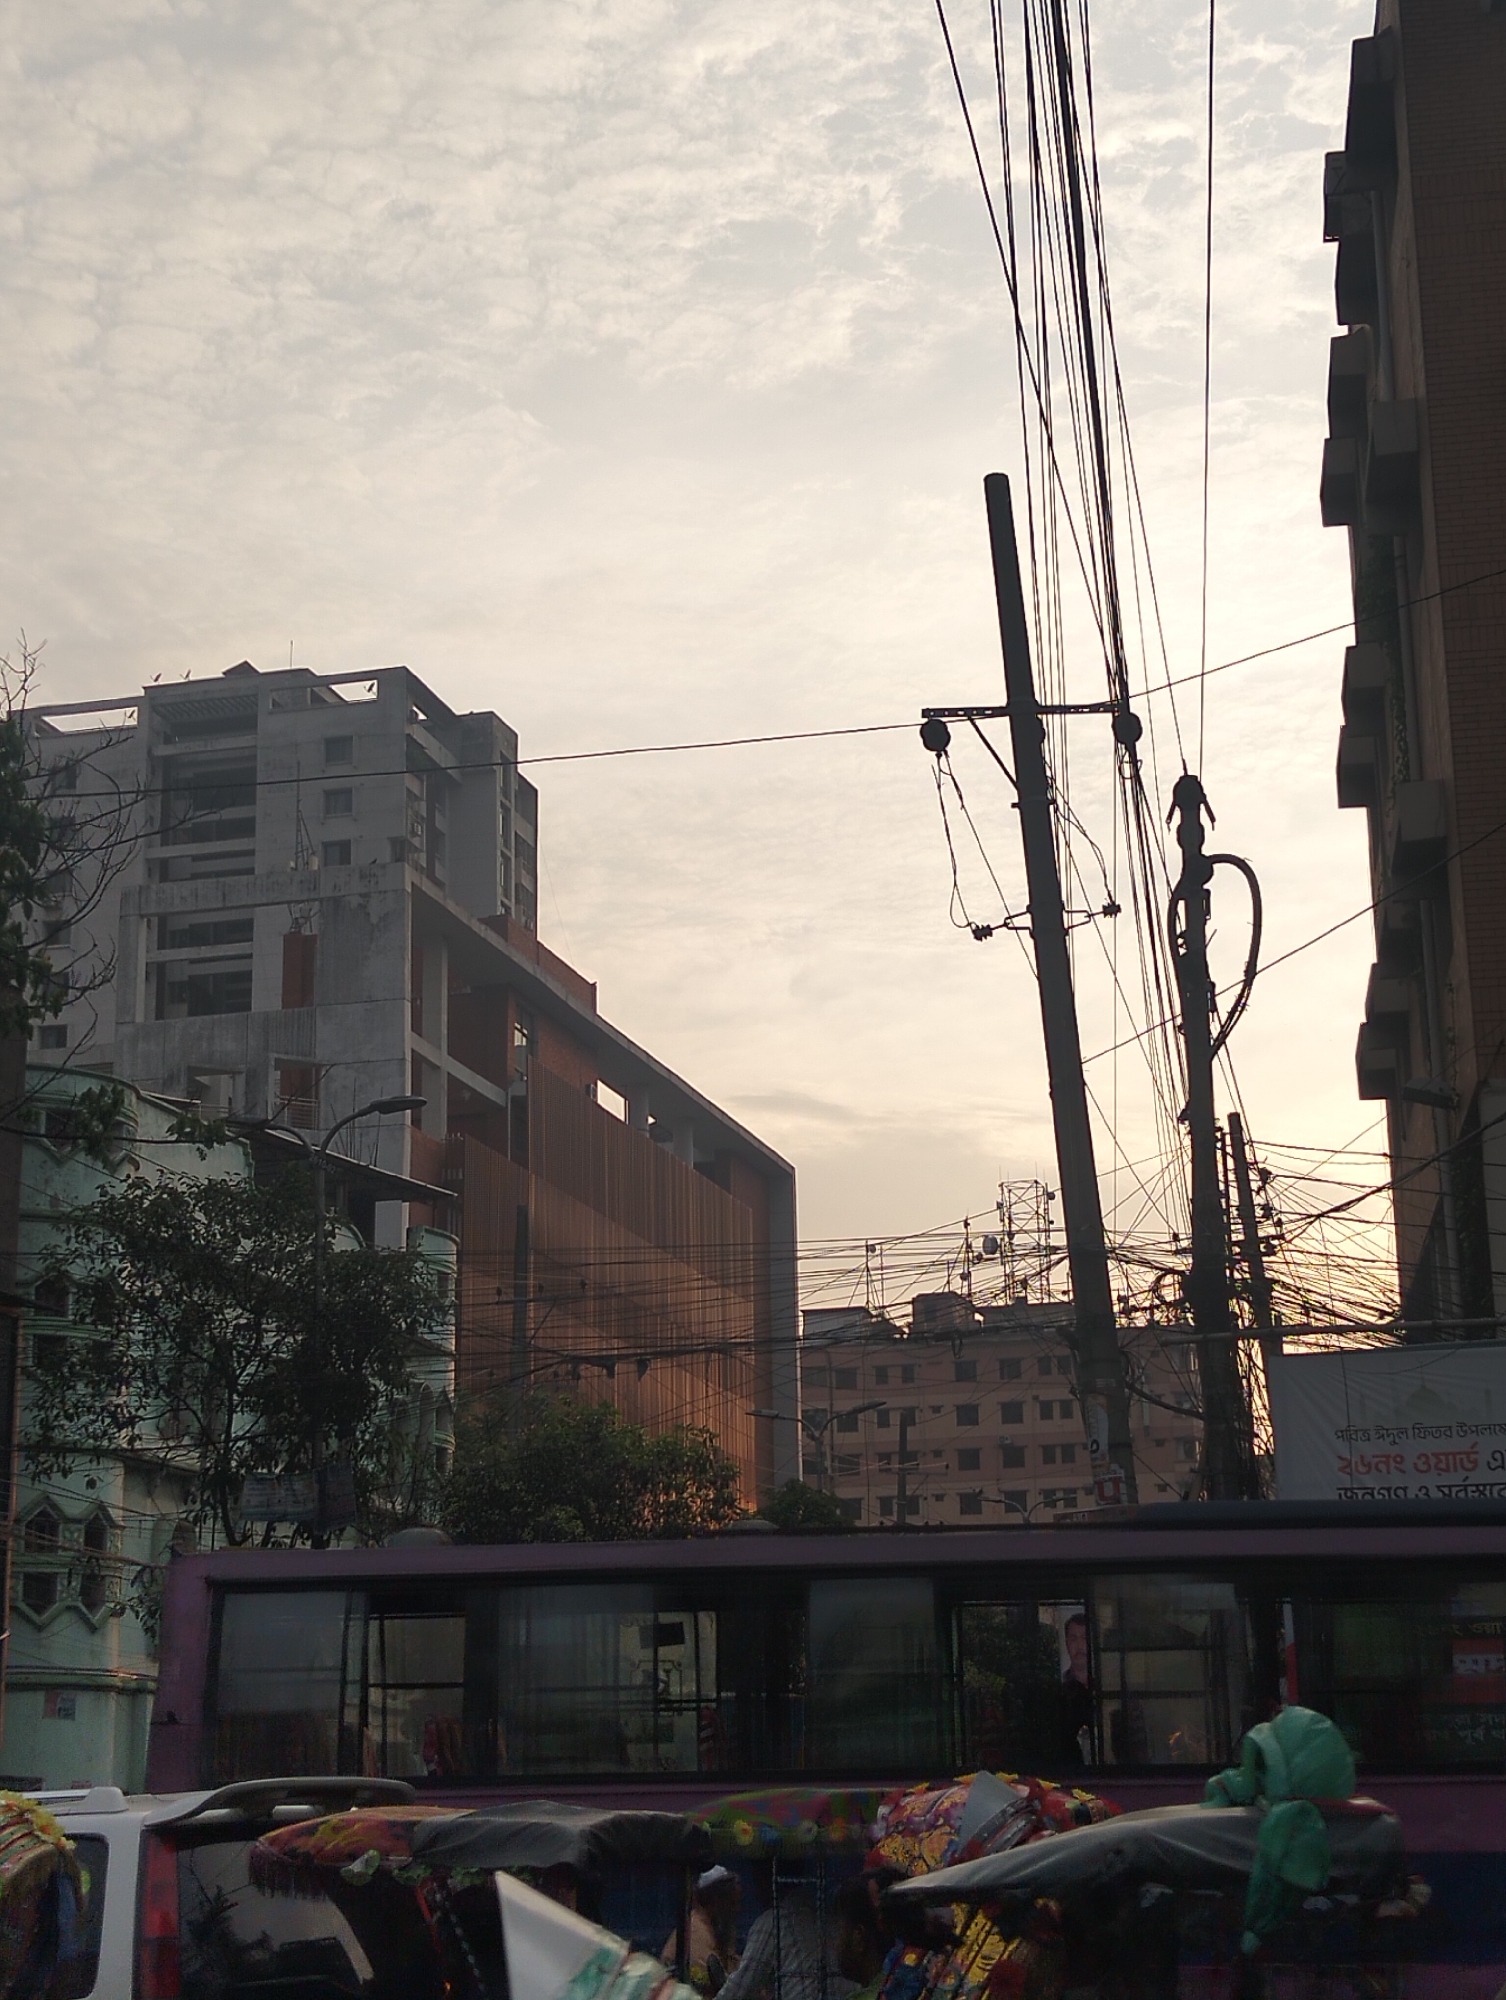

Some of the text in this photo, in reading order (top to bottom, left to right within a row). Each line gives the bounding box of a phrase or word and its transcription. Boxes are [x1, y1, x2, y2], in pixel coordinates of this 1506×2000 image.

[1335, 1424, 1370, 1442] পবিত্র
[1374, 1425, 1409, 1446] ঈদুল
[1412, 1422, 1453, 1440] ফিতর
[1336, 1453, 1406, 1476] ২৬নং
[1413, 1441, 1479, 1476] ওয়ার্ড
